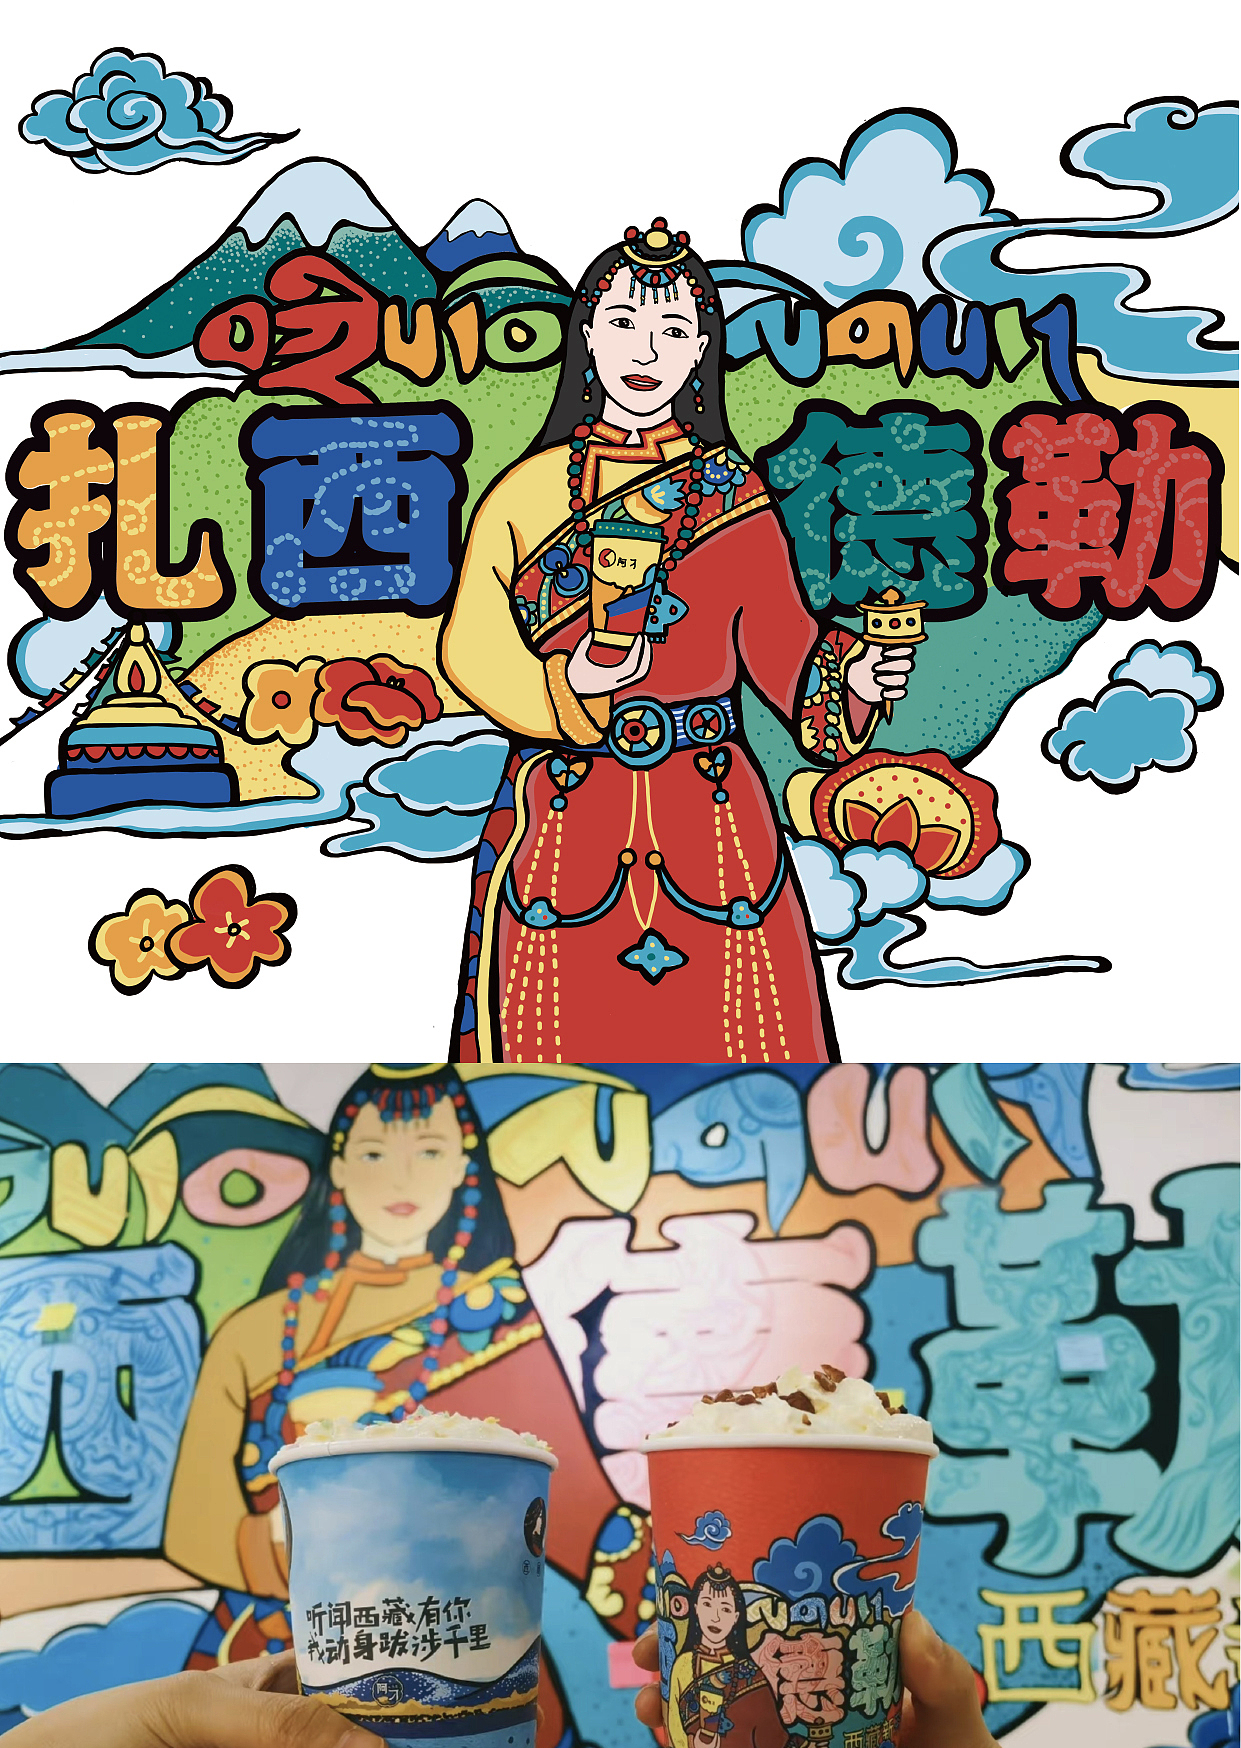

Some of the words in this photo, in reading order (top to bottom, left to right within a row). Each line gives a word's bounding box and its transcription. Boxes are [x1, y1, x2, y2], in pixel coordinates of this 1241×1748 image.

[306, 1595, 473, 1637] 听闻西藏有你
[306, 1623, 492, 1666] 我动身跋涉千里
[978, 1587, 1239, 1713] 西藏
